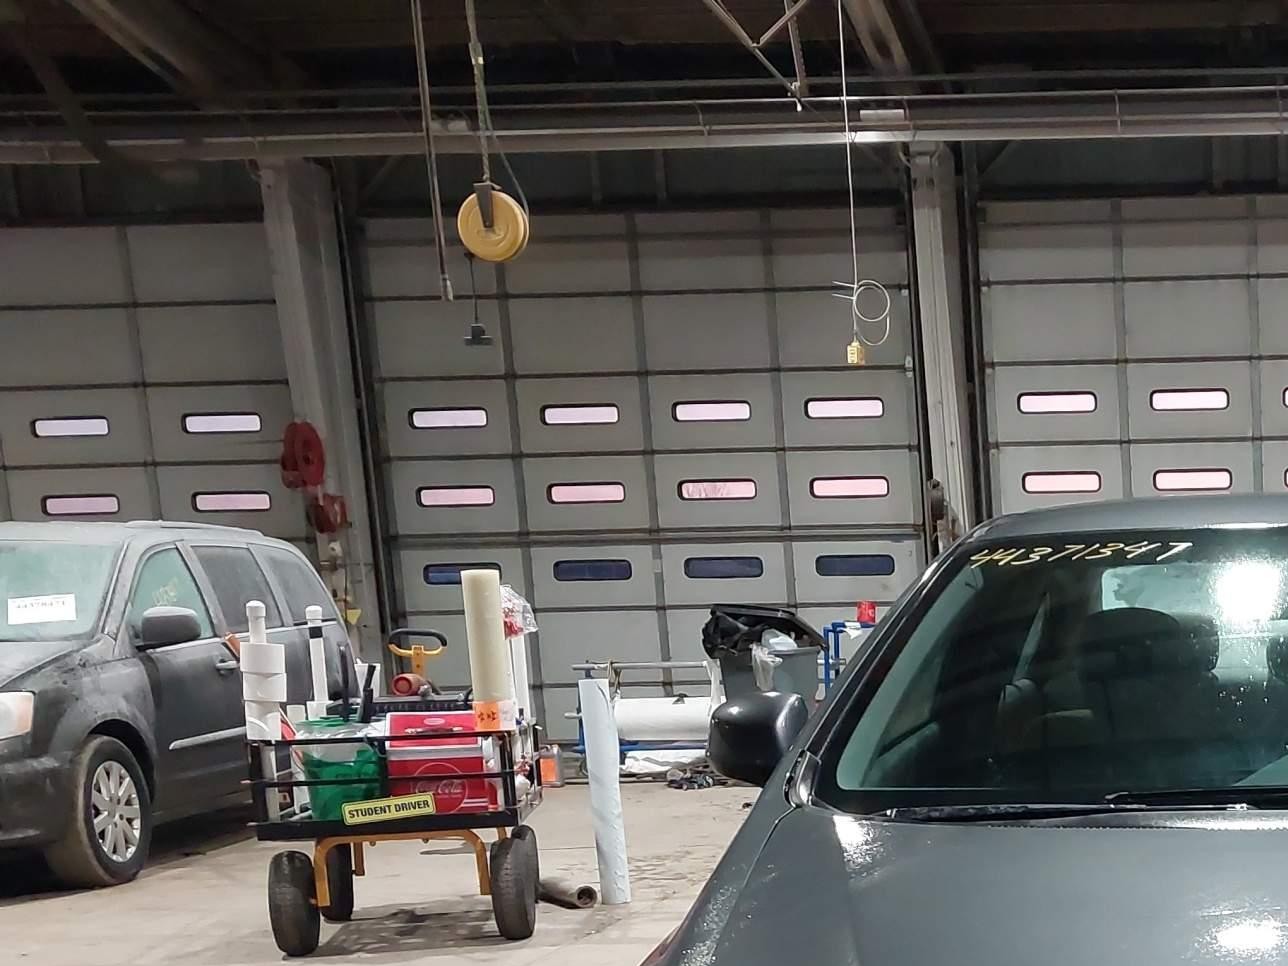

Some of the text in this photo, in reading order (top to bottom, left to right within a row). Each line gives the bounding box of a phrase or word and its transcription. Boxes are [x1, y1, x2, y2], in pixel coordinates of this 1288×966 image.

[969, 541, 1194, 569] 44371347
[347, 799, 430, 819] STUDENT DRIVER
